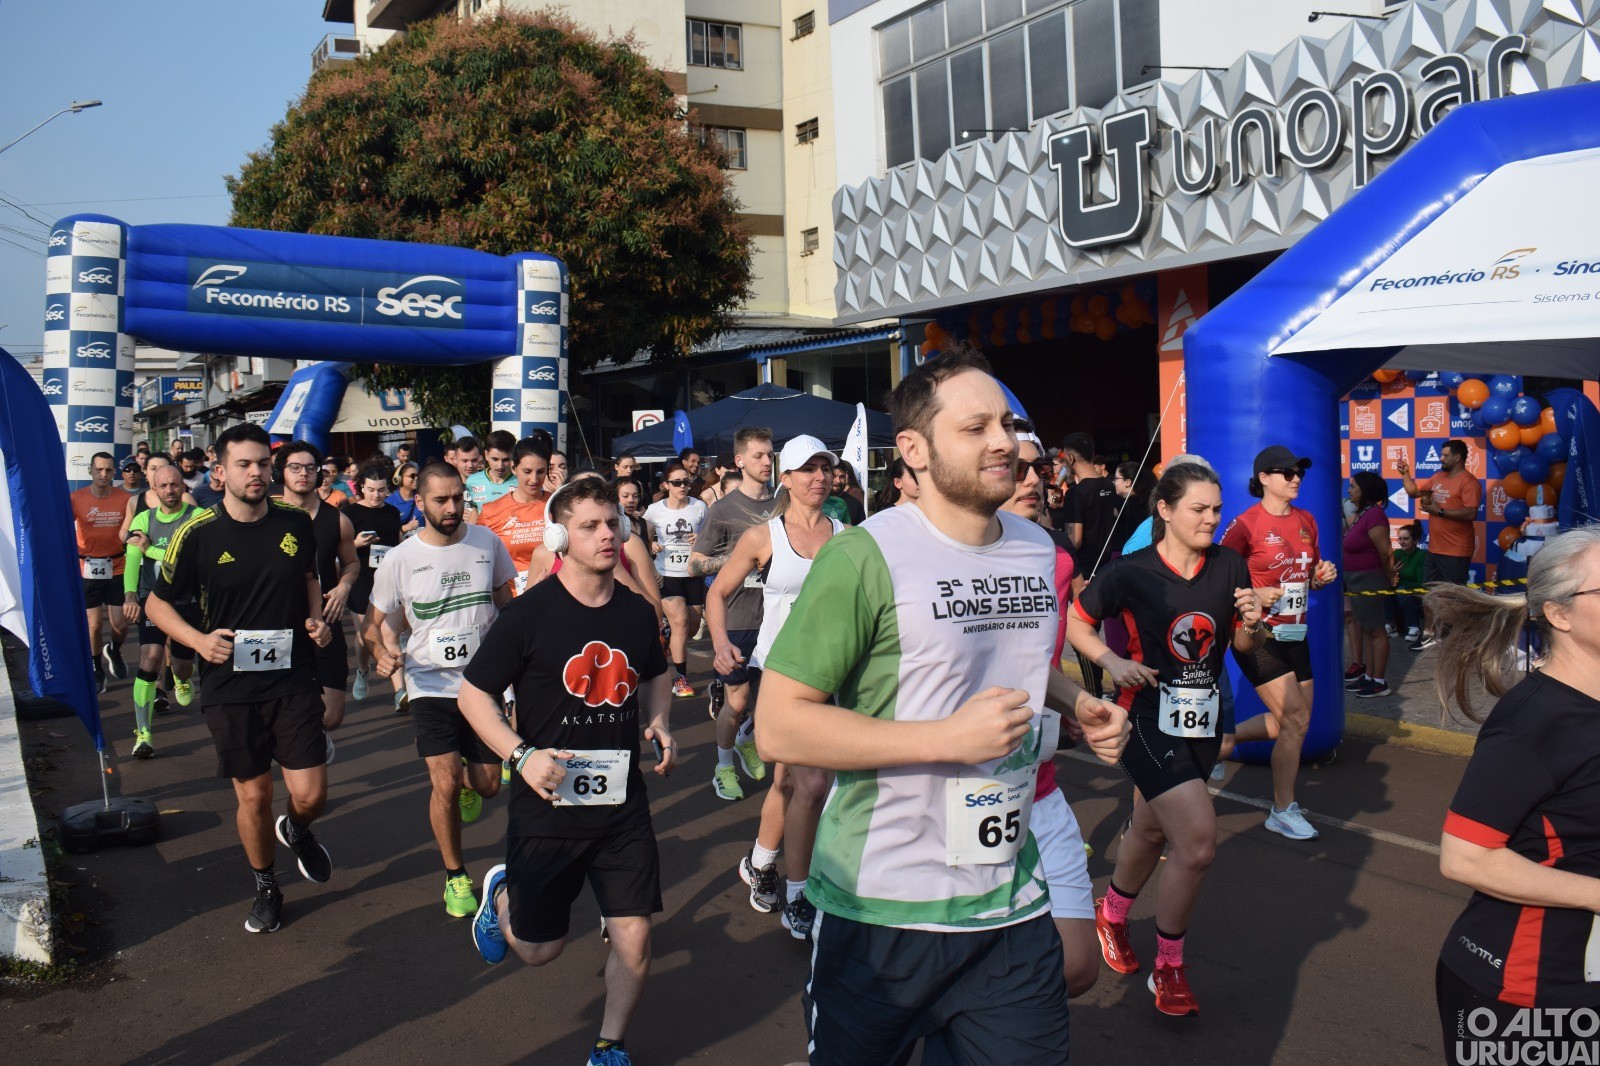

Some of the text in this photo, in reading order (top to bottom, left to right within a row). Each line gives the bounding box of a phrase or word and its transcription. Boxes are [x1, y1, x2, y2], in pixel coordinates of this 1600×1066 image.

[1172, 33, 1526, 195] unopar
[79, 272, 112, 284] Sesc
[1370, 268, 1485, 292] Fecomércio
[1490, 265, 1520, 280] RS
[206, 287, 350, 313] Fecomércio RS
[376, 286, 462, 319] Sesc
[1532, 293, 1591, 304] Sistema
[531, 304, 557, 316] Sesc
[76, 346, 111, 358] Sesc
[528, 370, 556, 380] Sesc
[494, 403, 516, 412] Sesc
[74, 420, 109, 433] Sesc
[1352, 461, 1380, 471] unopar
[1576, 467, 1588, 508] Sindicatos
[670, 555, 689, 563] 137
[92, 568, 106, 576] 44
[972, 574, 1049, 596] RÚSTICA
[932, 595, 1058, 620] LIONS SEBERI
[963, 620, 1040, 635] ANIVERSÁRIO 64 ANOS
[250, 648, 276, 664] 14
[444, 644, 468, 660] 84
[1170, 696, 1192, 705] Sesc
[1170, 710, 1210, 729] 184
[566, 760, 592, 768] Sesc
[574, 774, 608, 795] 63
[965, 792, 1003, 808] Sesc
[978, 809, 1020, 848] 65
